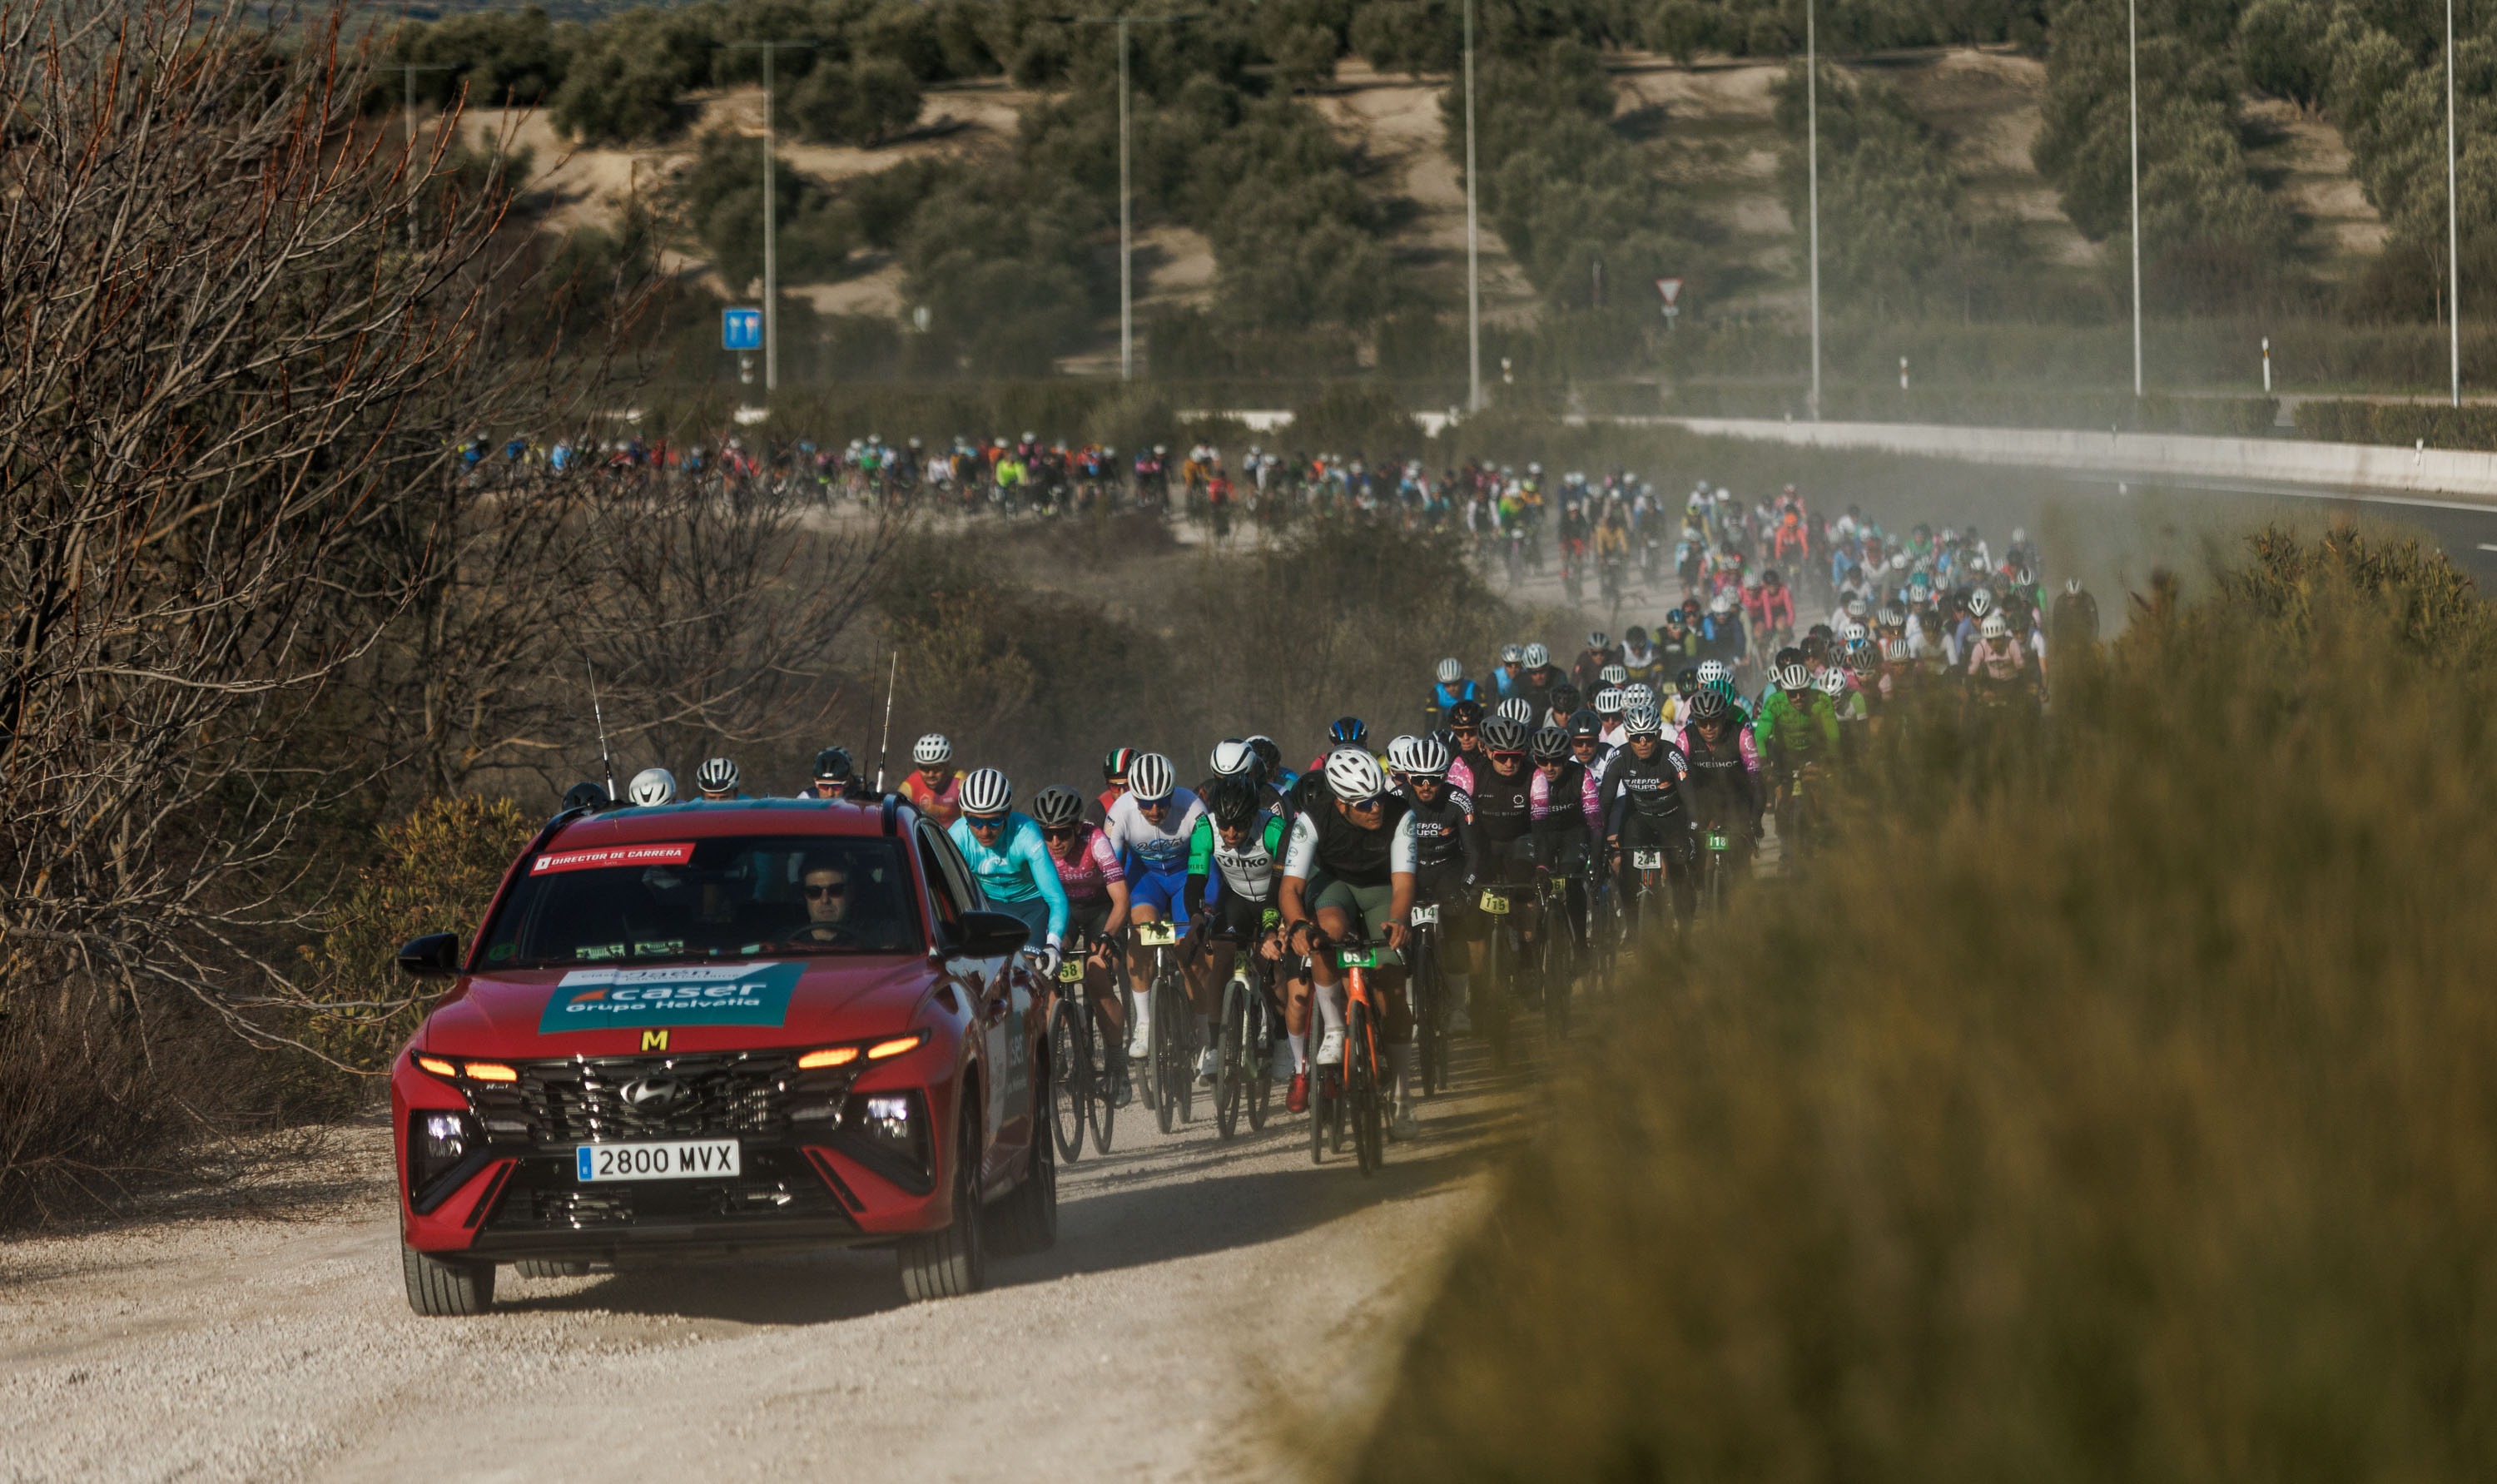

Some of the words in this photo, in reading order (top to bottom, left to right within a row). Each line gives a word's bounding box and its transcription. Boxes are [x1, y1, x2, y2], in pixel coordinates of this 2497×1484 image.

[1709, 836, 1726, 847] 118
[551, 851, 607, 866] DIRECTOR
[610, 851, 624, 859] DE
[628, 849, 682, 859] CARRERA
[1637, 855, 1657, 866] 244
[1486, 896, 1506, 911] 115
[1413, 906, 1435, 921] 114
[612, 983, 767, 1001] caser
[566, 1002, 647, 1013] Grupo
[655, 998, 761, 1010] Helvetia
[641, 1030, 668, 1051] M
[599, 1149, 668, 1175] 2800
[679, 1146, 732, 1172] MVX
